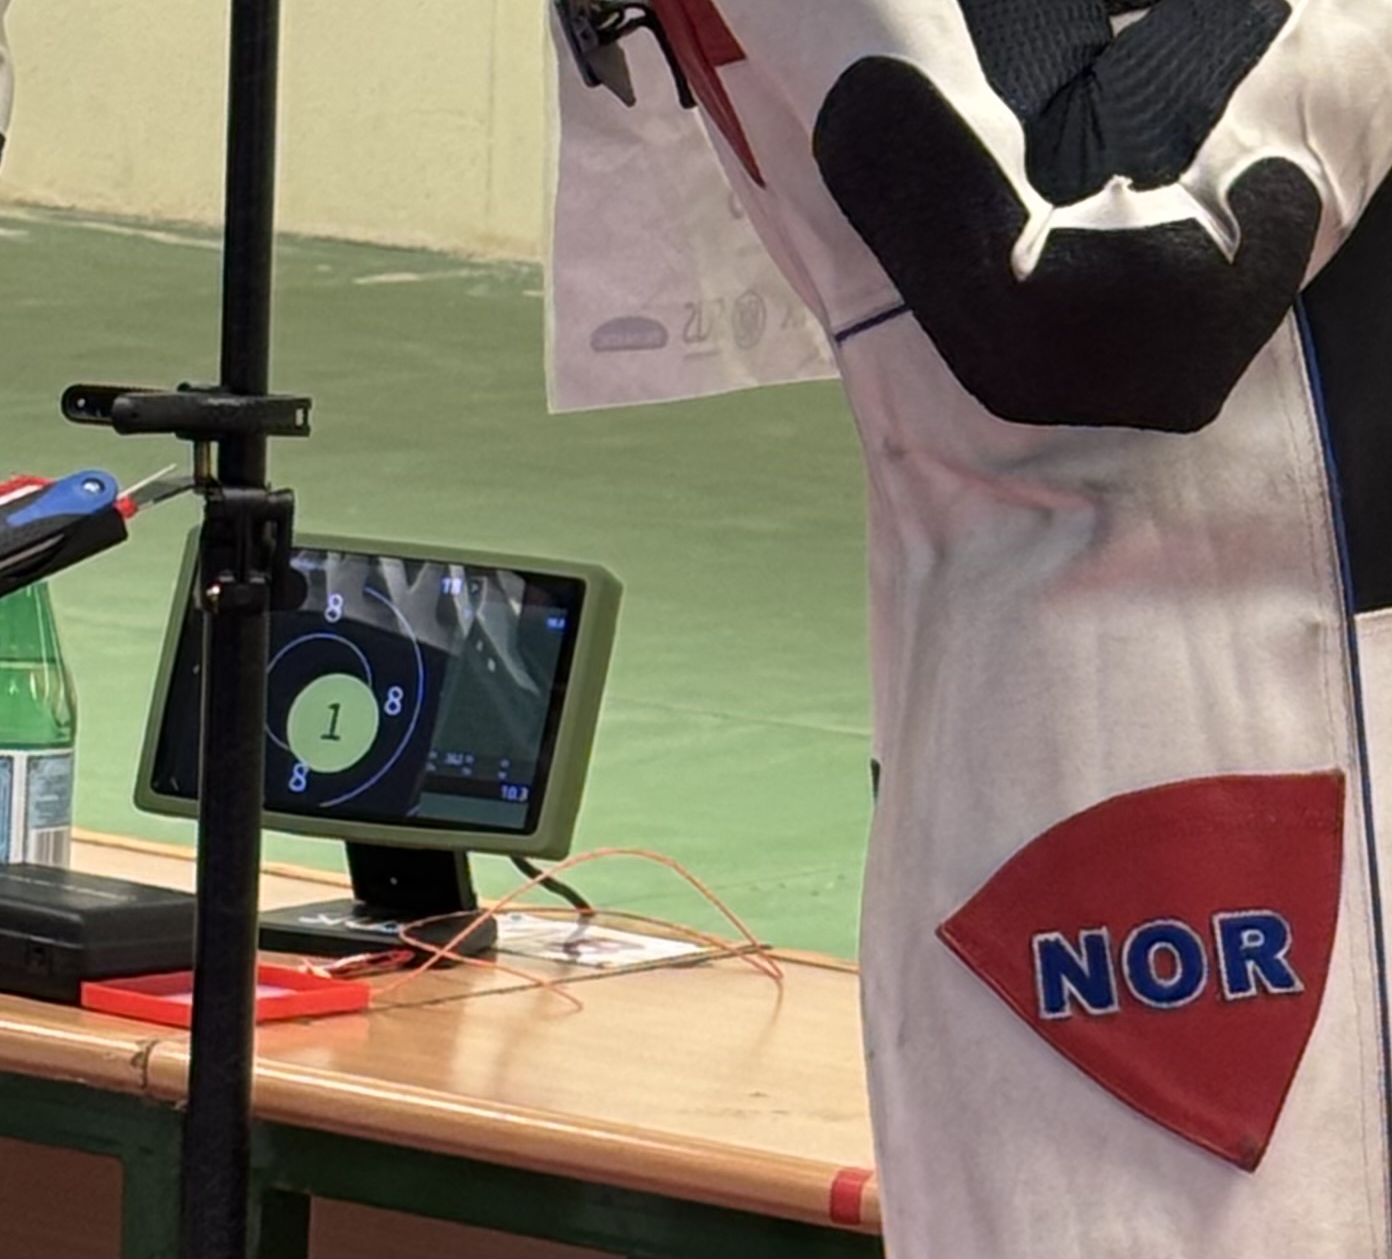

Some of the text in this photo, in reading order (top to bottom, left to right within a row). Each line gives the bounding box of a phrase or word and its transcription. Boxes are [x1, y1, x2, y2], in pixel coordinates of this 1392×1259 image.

[324, 593, 344, 623] 8
[384, 685, 404, 716] 8
[319, 702, 342, 742] 1
[288, 762, 309, 793] 8
[1031, 908, 1304, 1020] NOR
